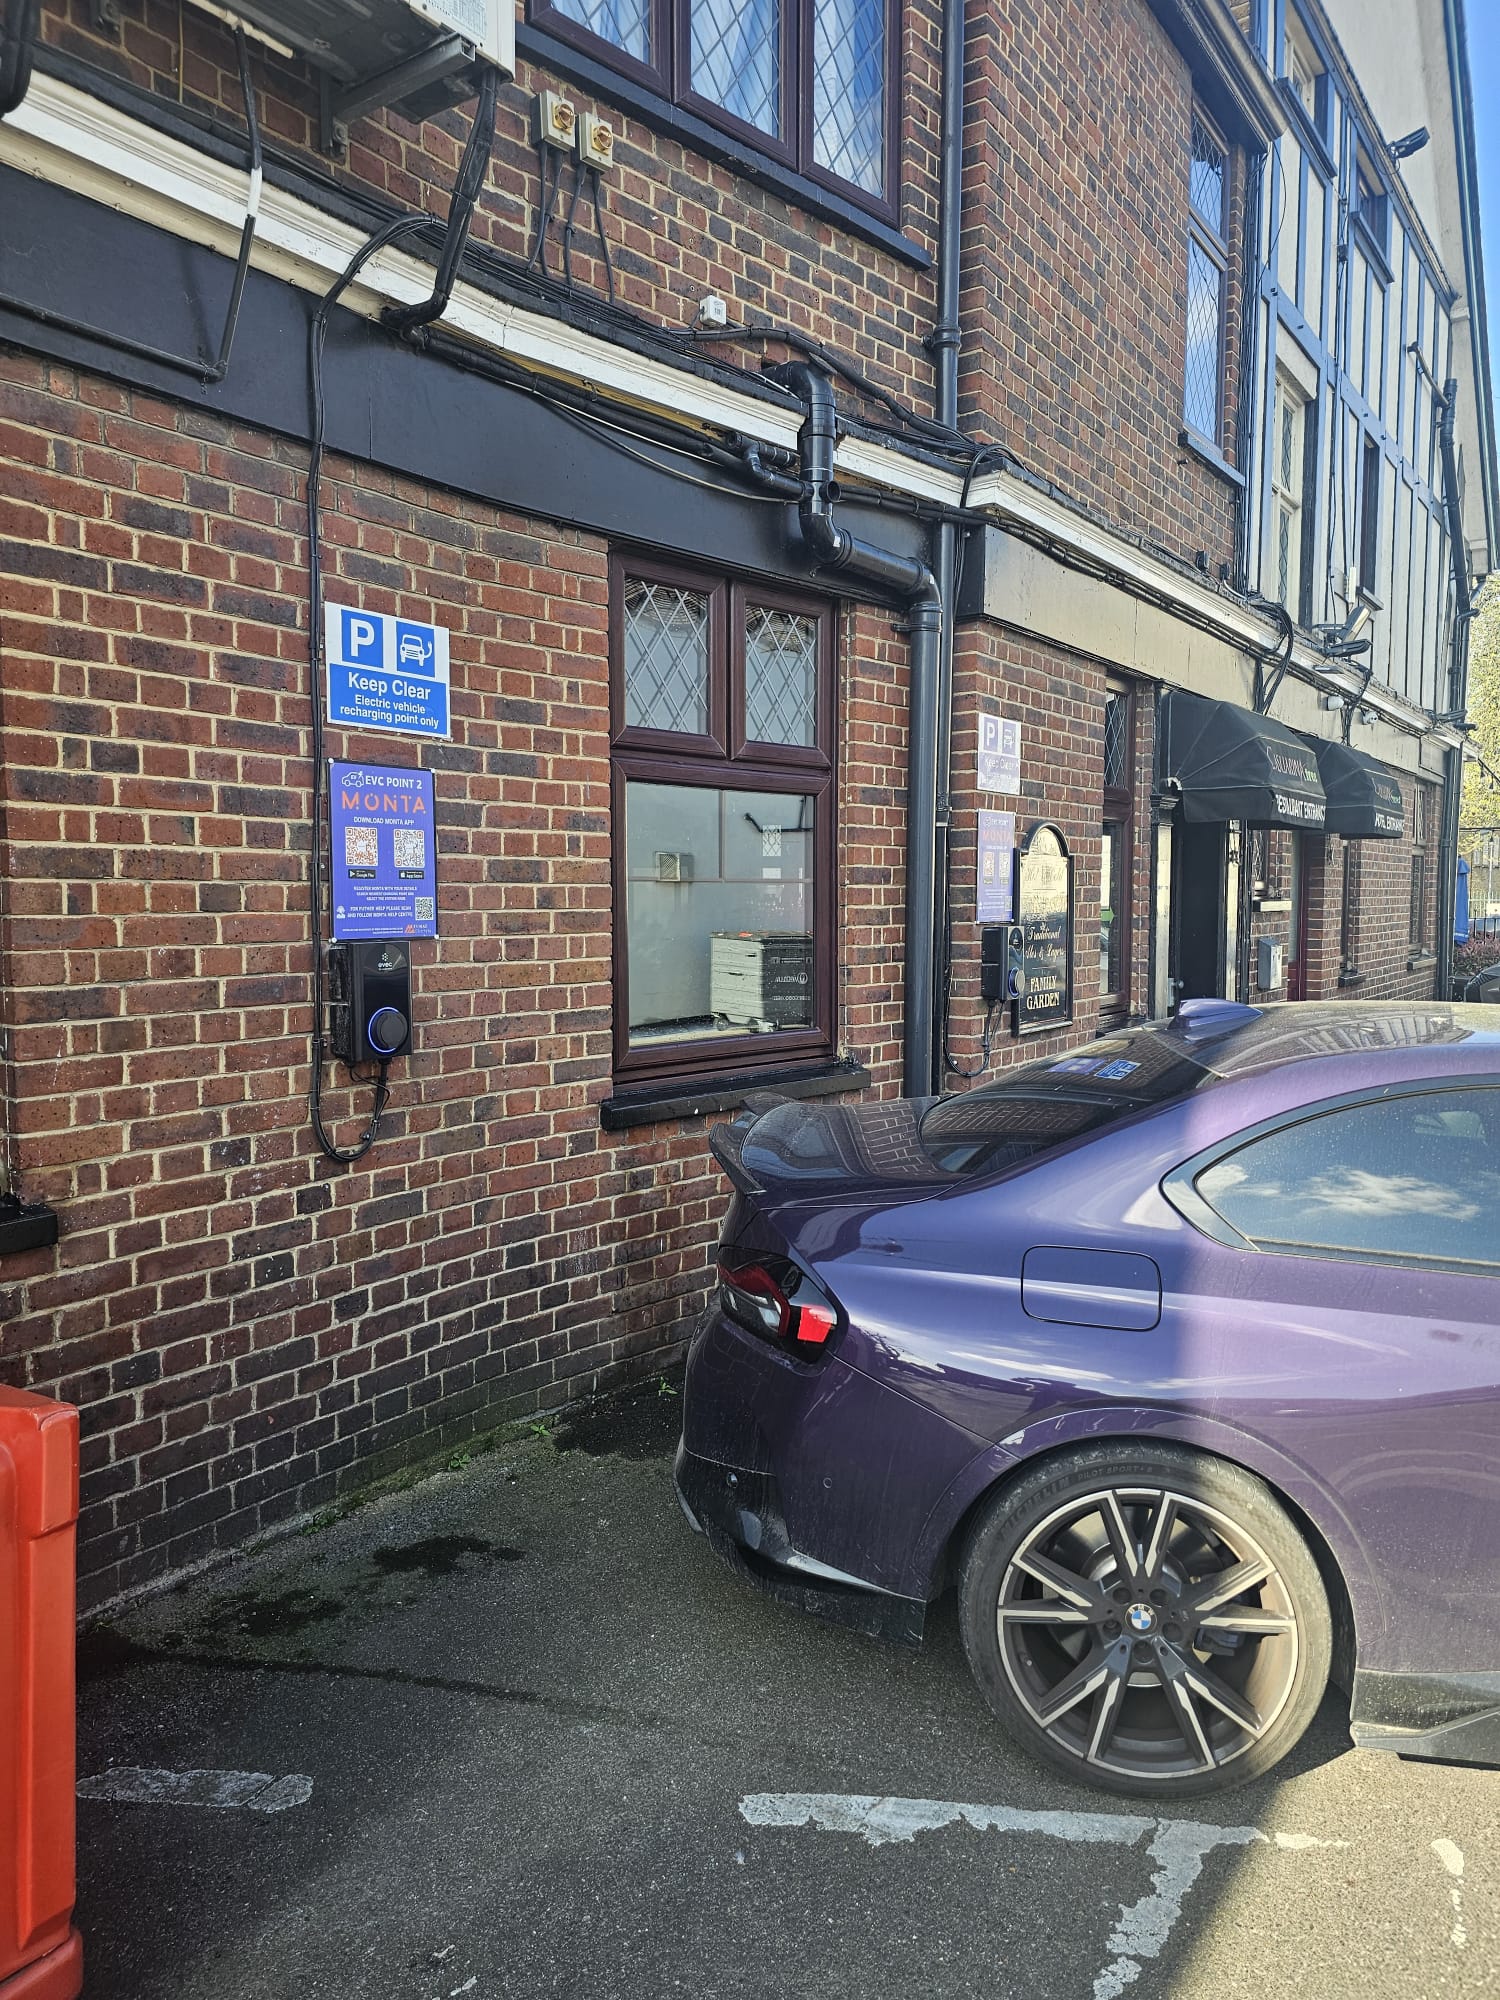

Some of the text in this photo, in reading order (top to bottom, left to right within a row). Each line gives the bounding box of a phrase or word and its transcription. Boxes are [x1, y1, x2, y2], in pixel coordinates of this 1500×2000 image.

[350, 618, 375, 657] P
[348, 671, 431, 700] Keep Clear
[355, 694, 426, 714] Electric vehicle
[340, 705, 439, 730] recharging point only
[986, 721, 996, 747] P
[365, 775, 385, 787] EVC
[386, 777, 415, 789] POINT
[416, 779, 423, 790] 2
[341, 789, 427, 815] MONTA
[353, 816, 384, 825] DOWNLOAD
[384, 817, 404, 826] MONTA
[1030, 975, 1057, 993] FAMILY
[1026, 991, 1060, 1010] GARDEN
[1077, 1467, 1104, 1482] PILOT
[1106, 1465, 1138, 1474] SPORT
